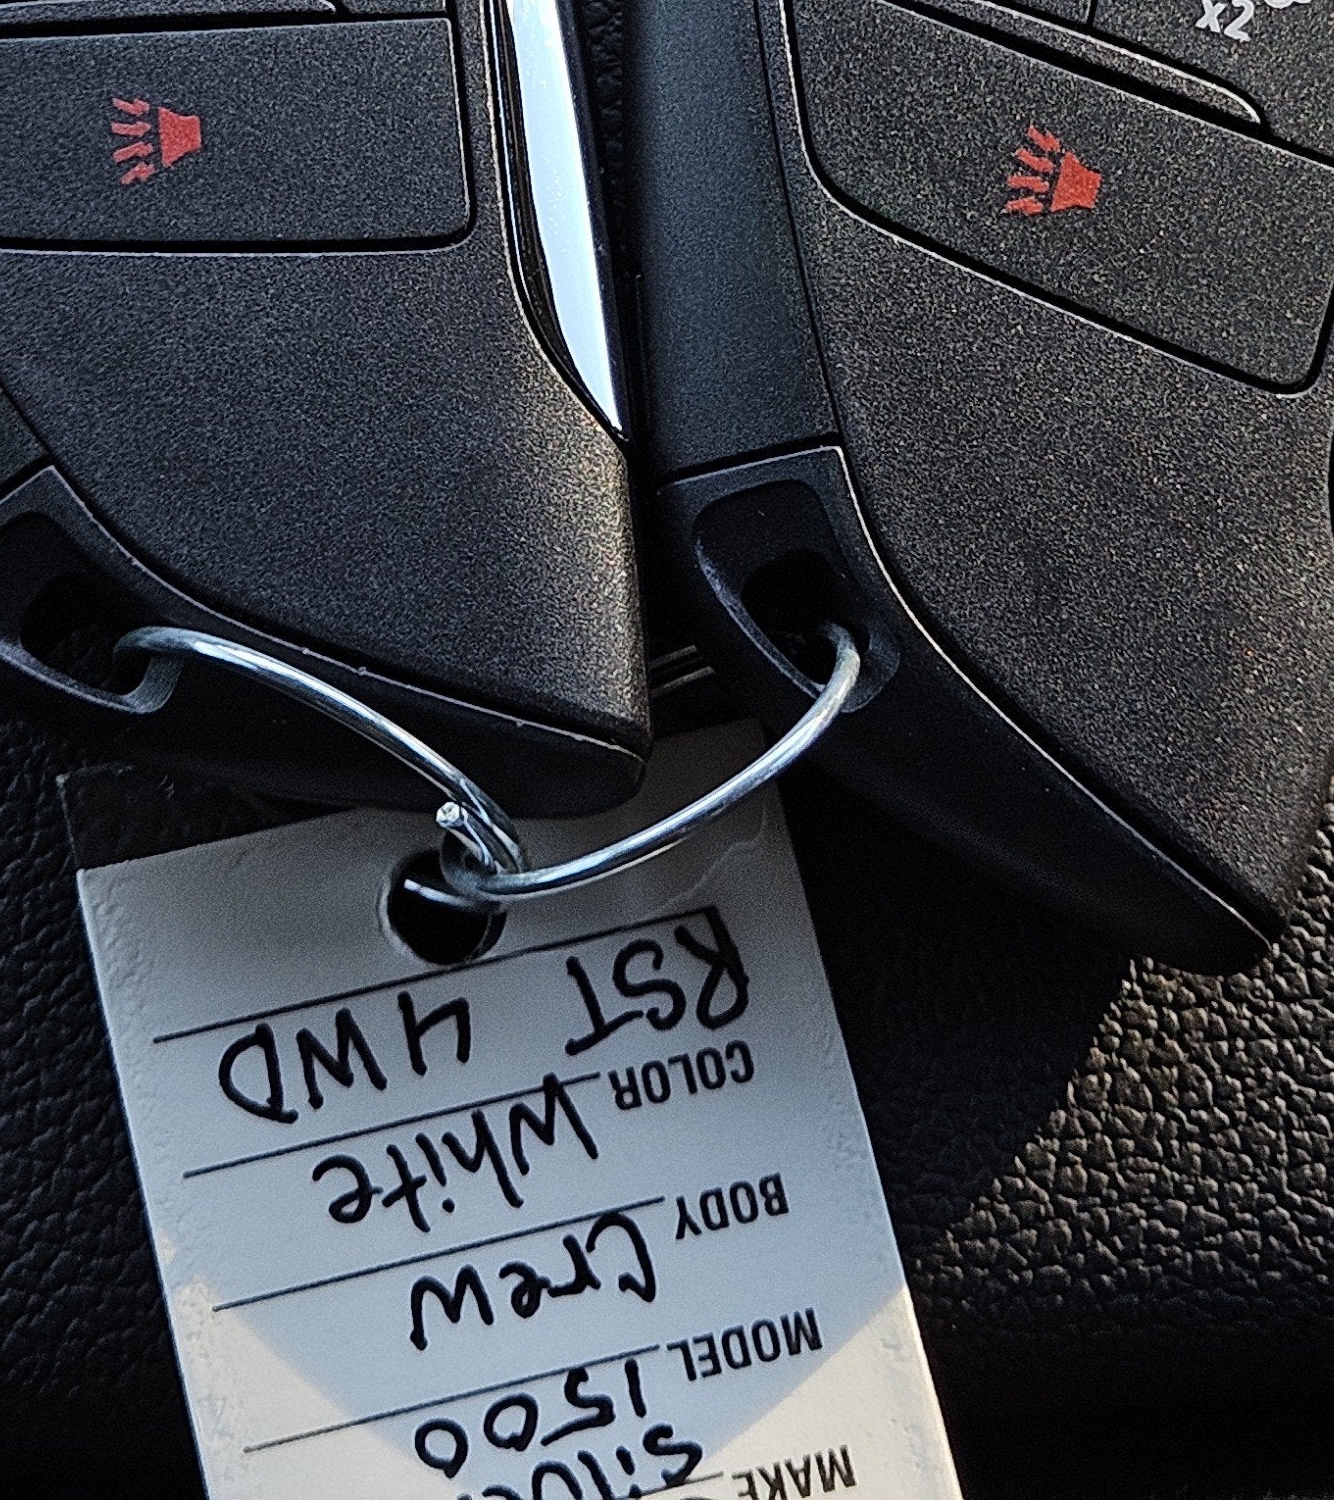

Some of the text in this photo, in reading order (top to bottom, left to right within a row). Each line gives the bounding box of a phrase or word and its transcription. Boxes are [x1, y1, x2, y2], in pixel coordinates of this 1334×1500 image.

[218, 908, 749, 1123] RST 4WD
[611, 1040, 756, 1110] COLOR
[674, 1173, 789, 1240] BODY
[668, 1308, 823, 1380] MODEL
[414, 1359, 648, 1477] 1500
[733, 1444, 859, 1500] MAKE
